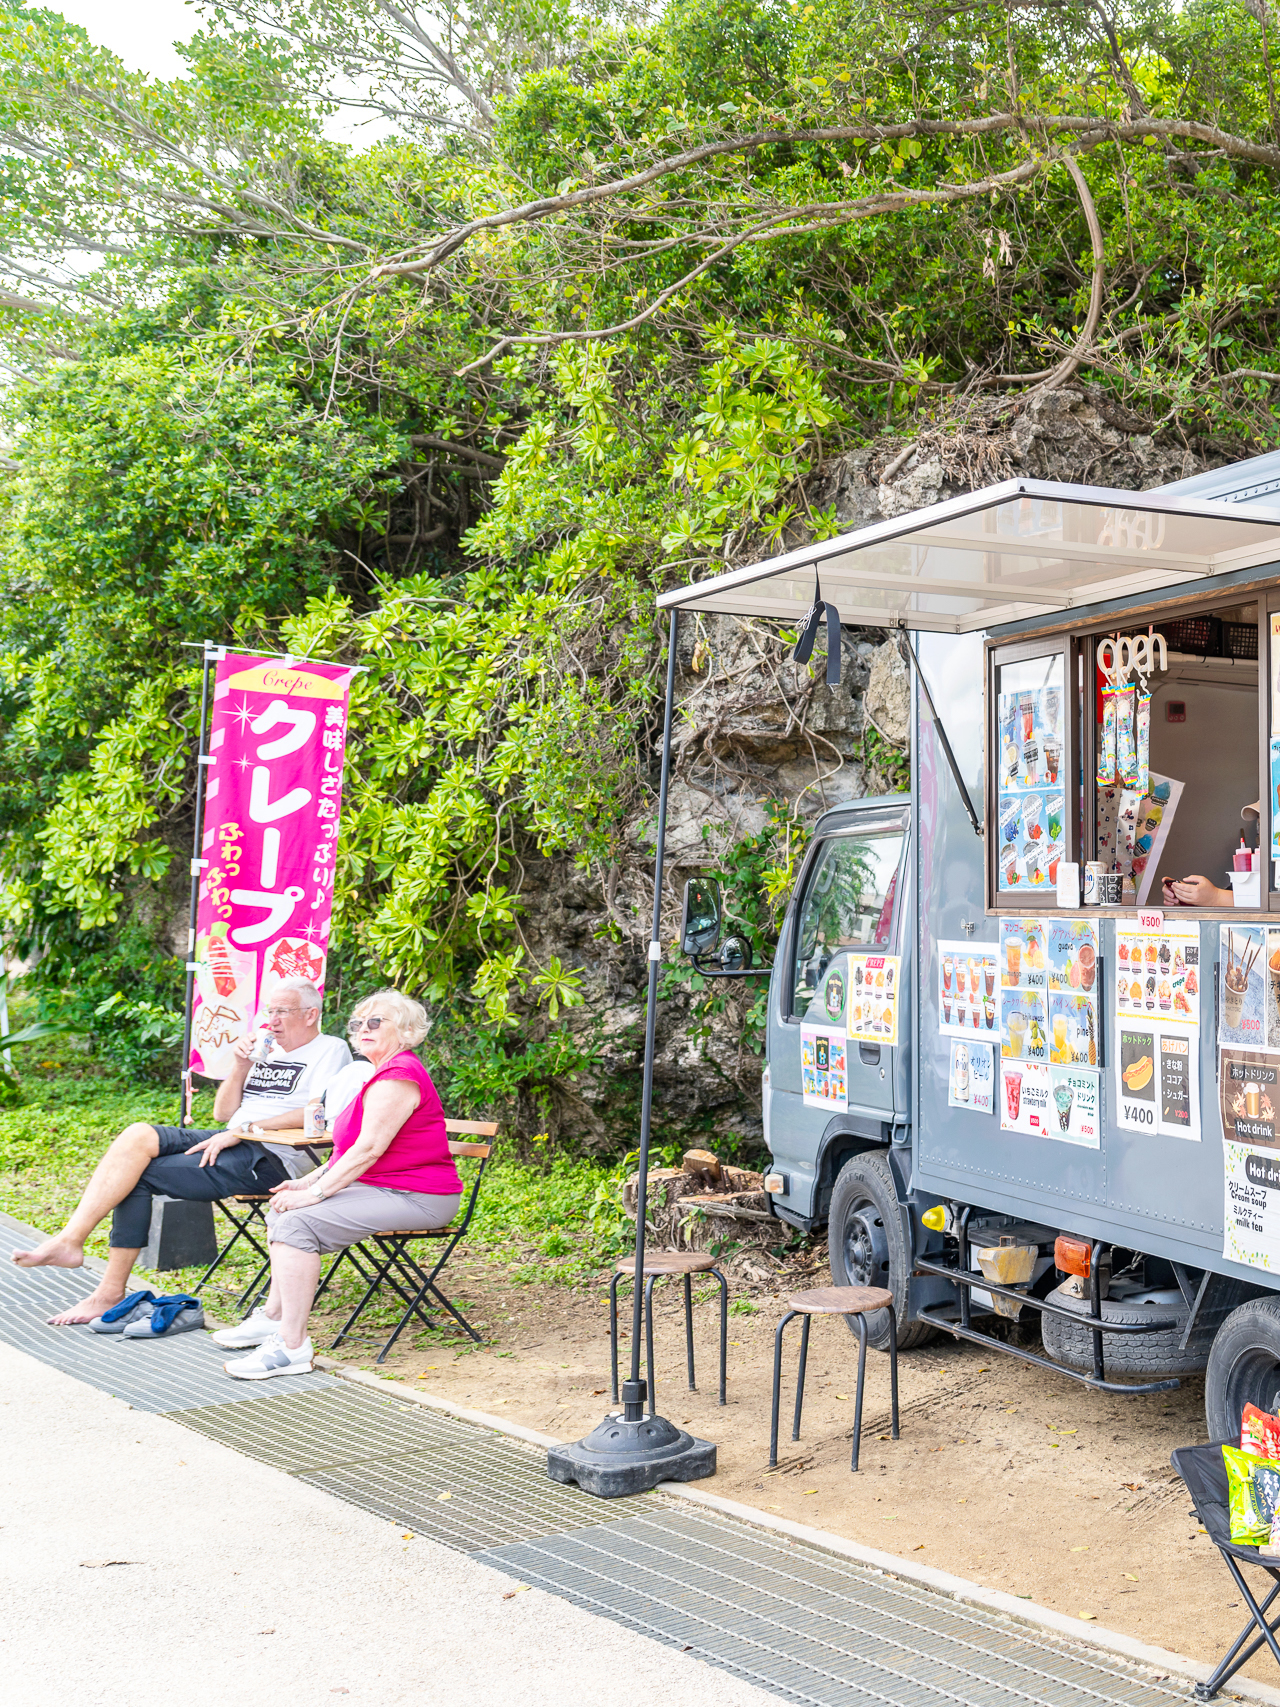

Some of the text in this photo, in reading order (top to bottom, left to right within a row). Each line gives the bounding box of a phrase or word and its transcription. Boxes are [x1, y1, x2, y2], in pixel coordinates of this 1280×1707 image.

[1097, 633, 1168, 686] open
[263, 670, 315, 696] Crepe
[230, 699, 318, 945] クレープ
[218, 822, 245, 877] ふわっ
[206, 867, 233, 919] ふわっ
[1004, 923, 1043, 933] マンゴージュース
[1141, 915, 1161, 928] ¥500
[1057, 943, 1073, 953] guava
[1028, 974, 1043, 985] ¥400
[1051, 973, 1068, 984] ¥400
[1172, 976, 1185, 989] crepe
[1052, 997, 1093, 1011] パインジュース
[1076, 1025, 1089, 1038] pine
[1241, 1019, 1260, 1031] ¥500
[1028, 1045, 1045, 1057] ¥400
[1162, 1040, 1188, 1054] あげパン
[970, 1056, 991, 1069] オリオン
[1070, 1051, 1088, 1063] ¥400
[1166, 1059, 1183, 1072] きな粉
[973, 1069, 990, 1081] ビール
[1166, 1074, 1183, 1086] ココア
[1232, 1067, 1275, 1082] ホットドリンク
[1067, 1077, 1095, 1090] チョコミント
[1021, 1086, 1049, 1099] いちごミルク
[1077, 1091, 1095, 1104] ドリンク
[1166, 1089, 1189, 1101] シュガー
[973, 1093, 989, 1108] ¥400
[1123, 1104, 1154, 1125] ¥400
[1174, 1109, 1189, 1119] ¥200
[1081, 1125, 1094, 1135] ¥500
[1236, 1121, 1273, 1137] Hot drink
[1249, 1163, 1266, 1179] Hot
[1228, 1180, 1267, 1200] クリームスープ
[1230, 1190, 1268, 1211] Cream soup
[1233, 1204, 1264, 1221] ミルクティー
[1236, 1216, 1263, 1233] milk tea
